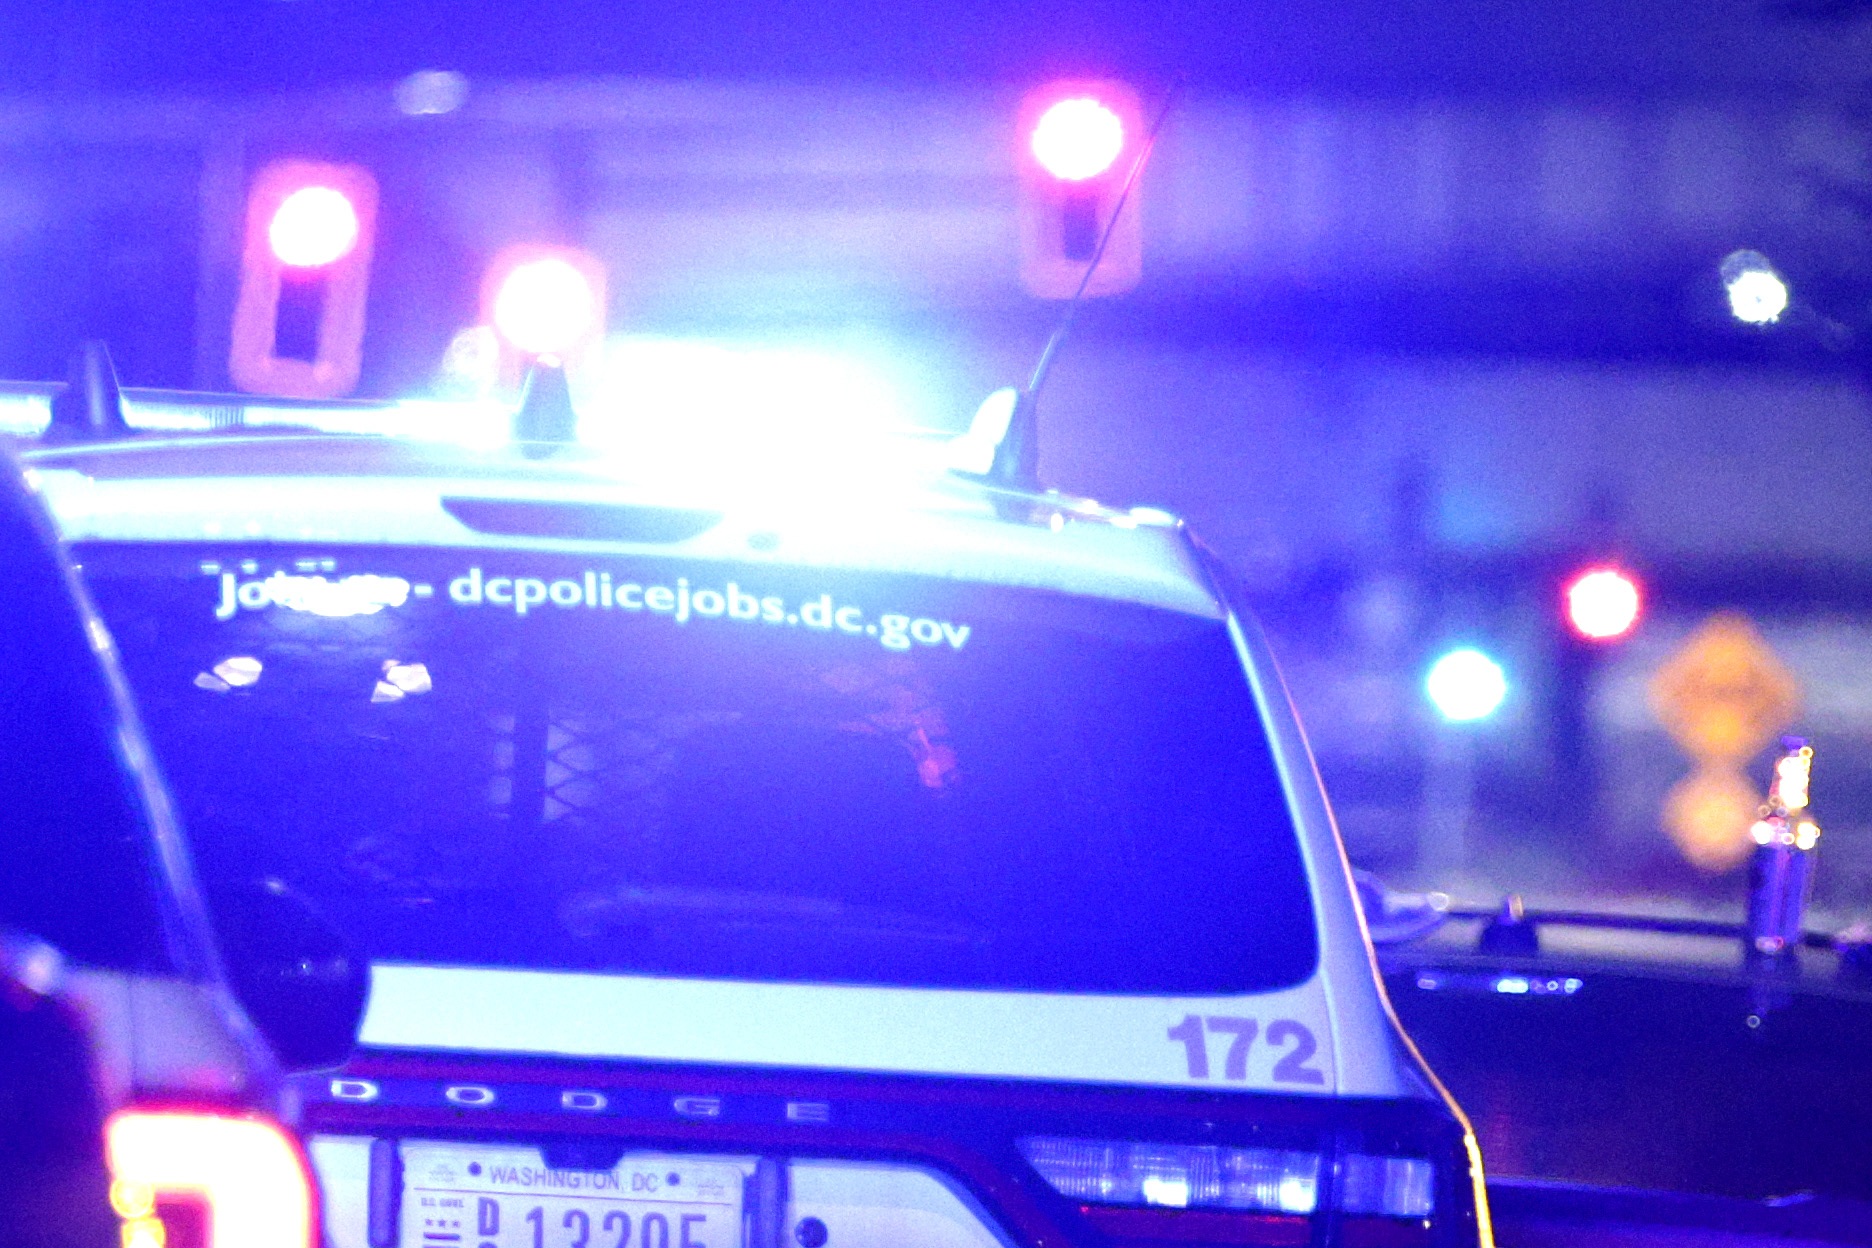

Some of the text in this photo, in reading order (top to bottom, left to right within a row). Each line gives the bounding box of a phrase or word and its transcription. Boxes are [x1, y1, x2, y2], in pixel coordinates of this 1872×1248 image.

[449, 568, 970, 651] dcpolicejobs.dc.gov
[1167, 1014, 1325, 1085] 172
[330, 1079, 830, 1122] DODGE
[631, 1172, 659, 1194] DC
